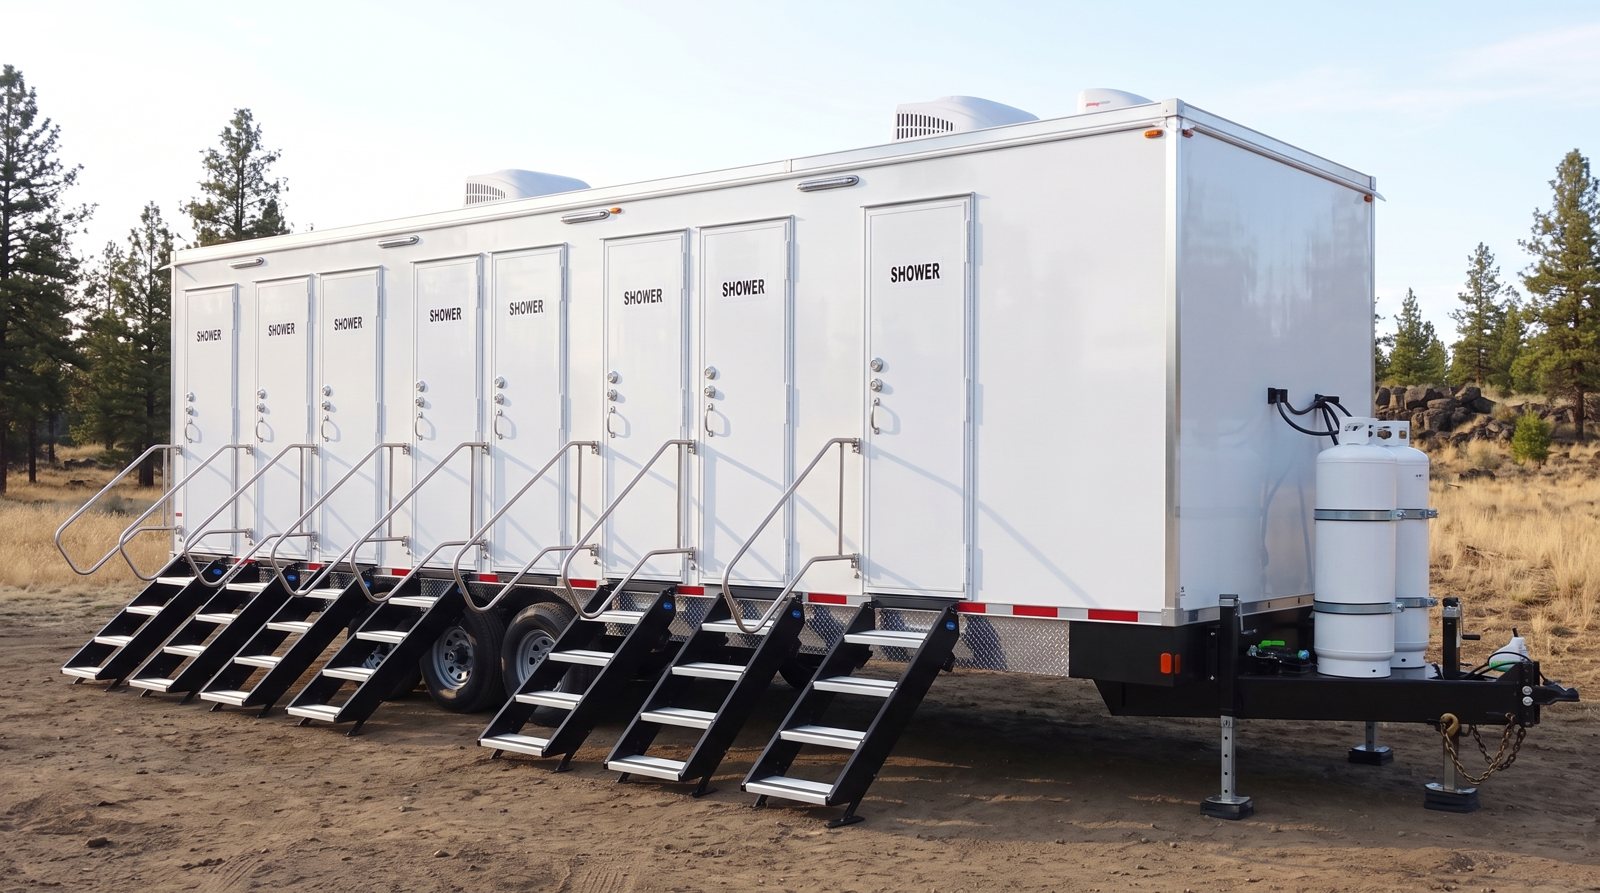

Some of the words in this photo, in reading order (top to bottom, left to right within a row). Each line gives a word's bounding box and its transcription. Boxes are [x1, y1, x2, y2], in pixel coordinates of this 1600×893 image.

[891, 262, 940, 283] SHOWER
[722, 279, 765, 297] SHOWER
[624, 288, 662, 305] SHOWER
[430, 307, 462, 322] SHOWER
[510, 299, 543, 315] SHOWER
[268, 322, 295, 337] SHOWER
[334, 316, 363, 331] SHOWER
[196, 329, 222, 342] SHOWER
